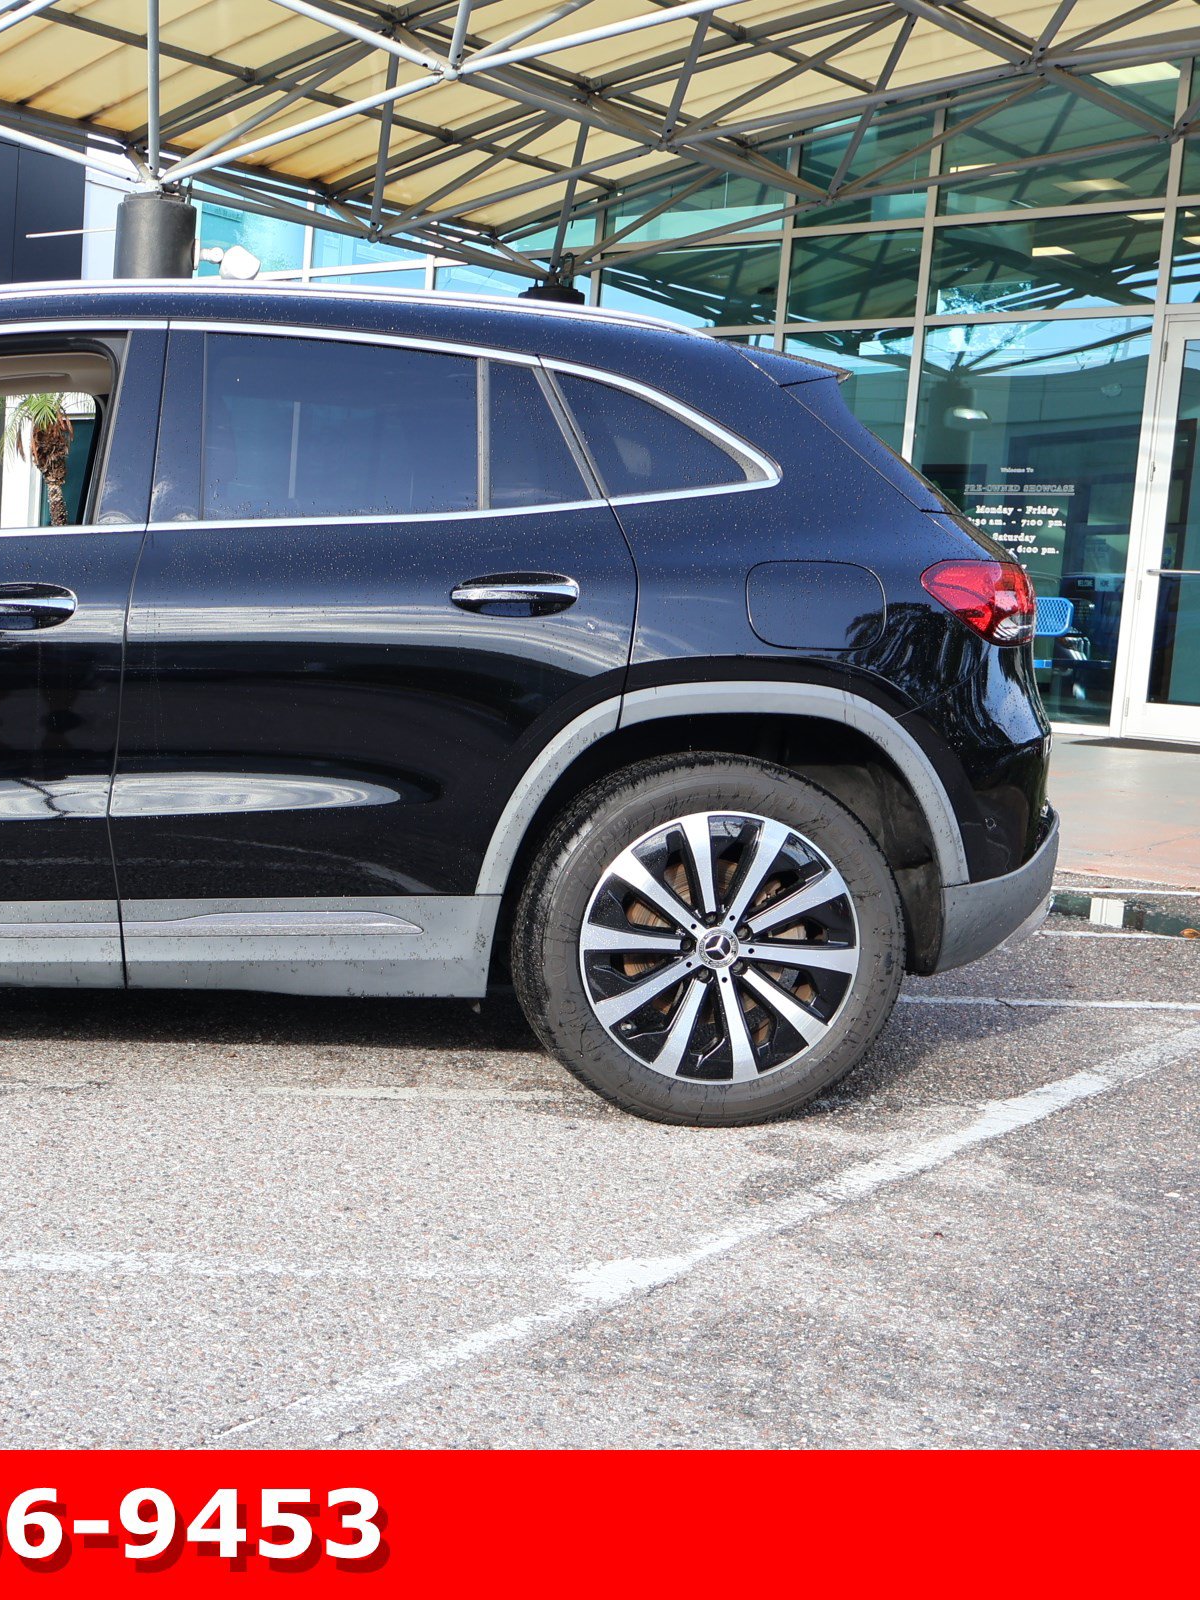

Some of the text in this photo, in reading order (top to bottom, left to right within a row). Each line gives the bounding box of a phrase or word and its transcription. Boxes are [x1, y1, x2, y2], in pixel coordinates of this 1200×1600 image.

[964, 484, 1075, 492] PRE-OWNED SHOWCASE
[975, 505, 1014, 515] Monday
[1025, 505, 1059, 516] Friday
[967, 517, 987, 527] :30
[1021, 518, 1043, 527] 7:00
[1047, 519, 1066, 527] pm.
[991, 532, 1036, 543] Saturday
[1016, 545, 1038, 554] 6:00
[1041, 547, 1059, 555] pm.
